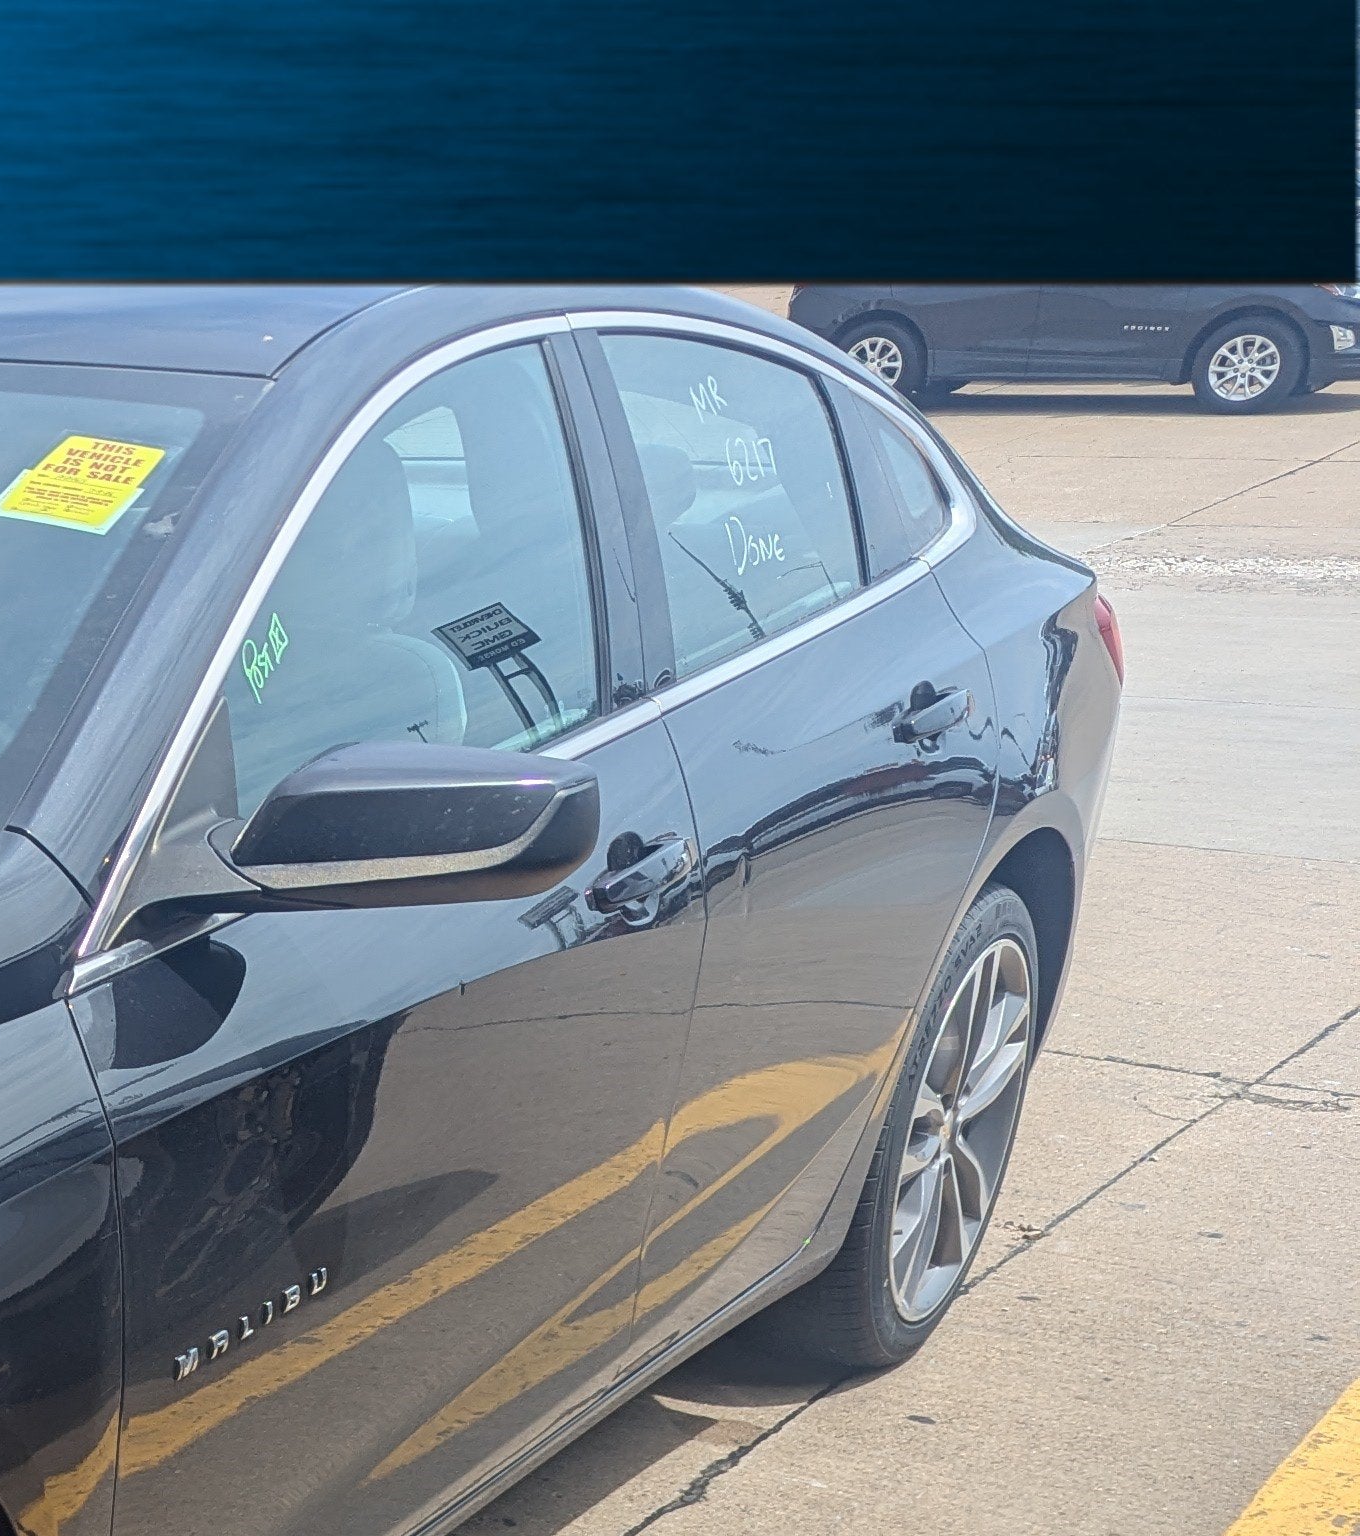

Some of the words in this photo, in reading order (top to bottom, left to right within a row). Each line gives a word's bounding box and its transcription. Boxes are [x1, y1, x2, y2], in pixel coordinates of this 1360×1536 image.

[66, 448, 145, 467] VEHICLE
[92, 441, 137, 455] THIS
[42, 463, 82, 476] FOR
[86, 471, 136, 485] SALE
[62, 457, 84, 467] IS
[88, 459, 129, 474] NOT
[174, 1267, 328, 1382] MALIBU
